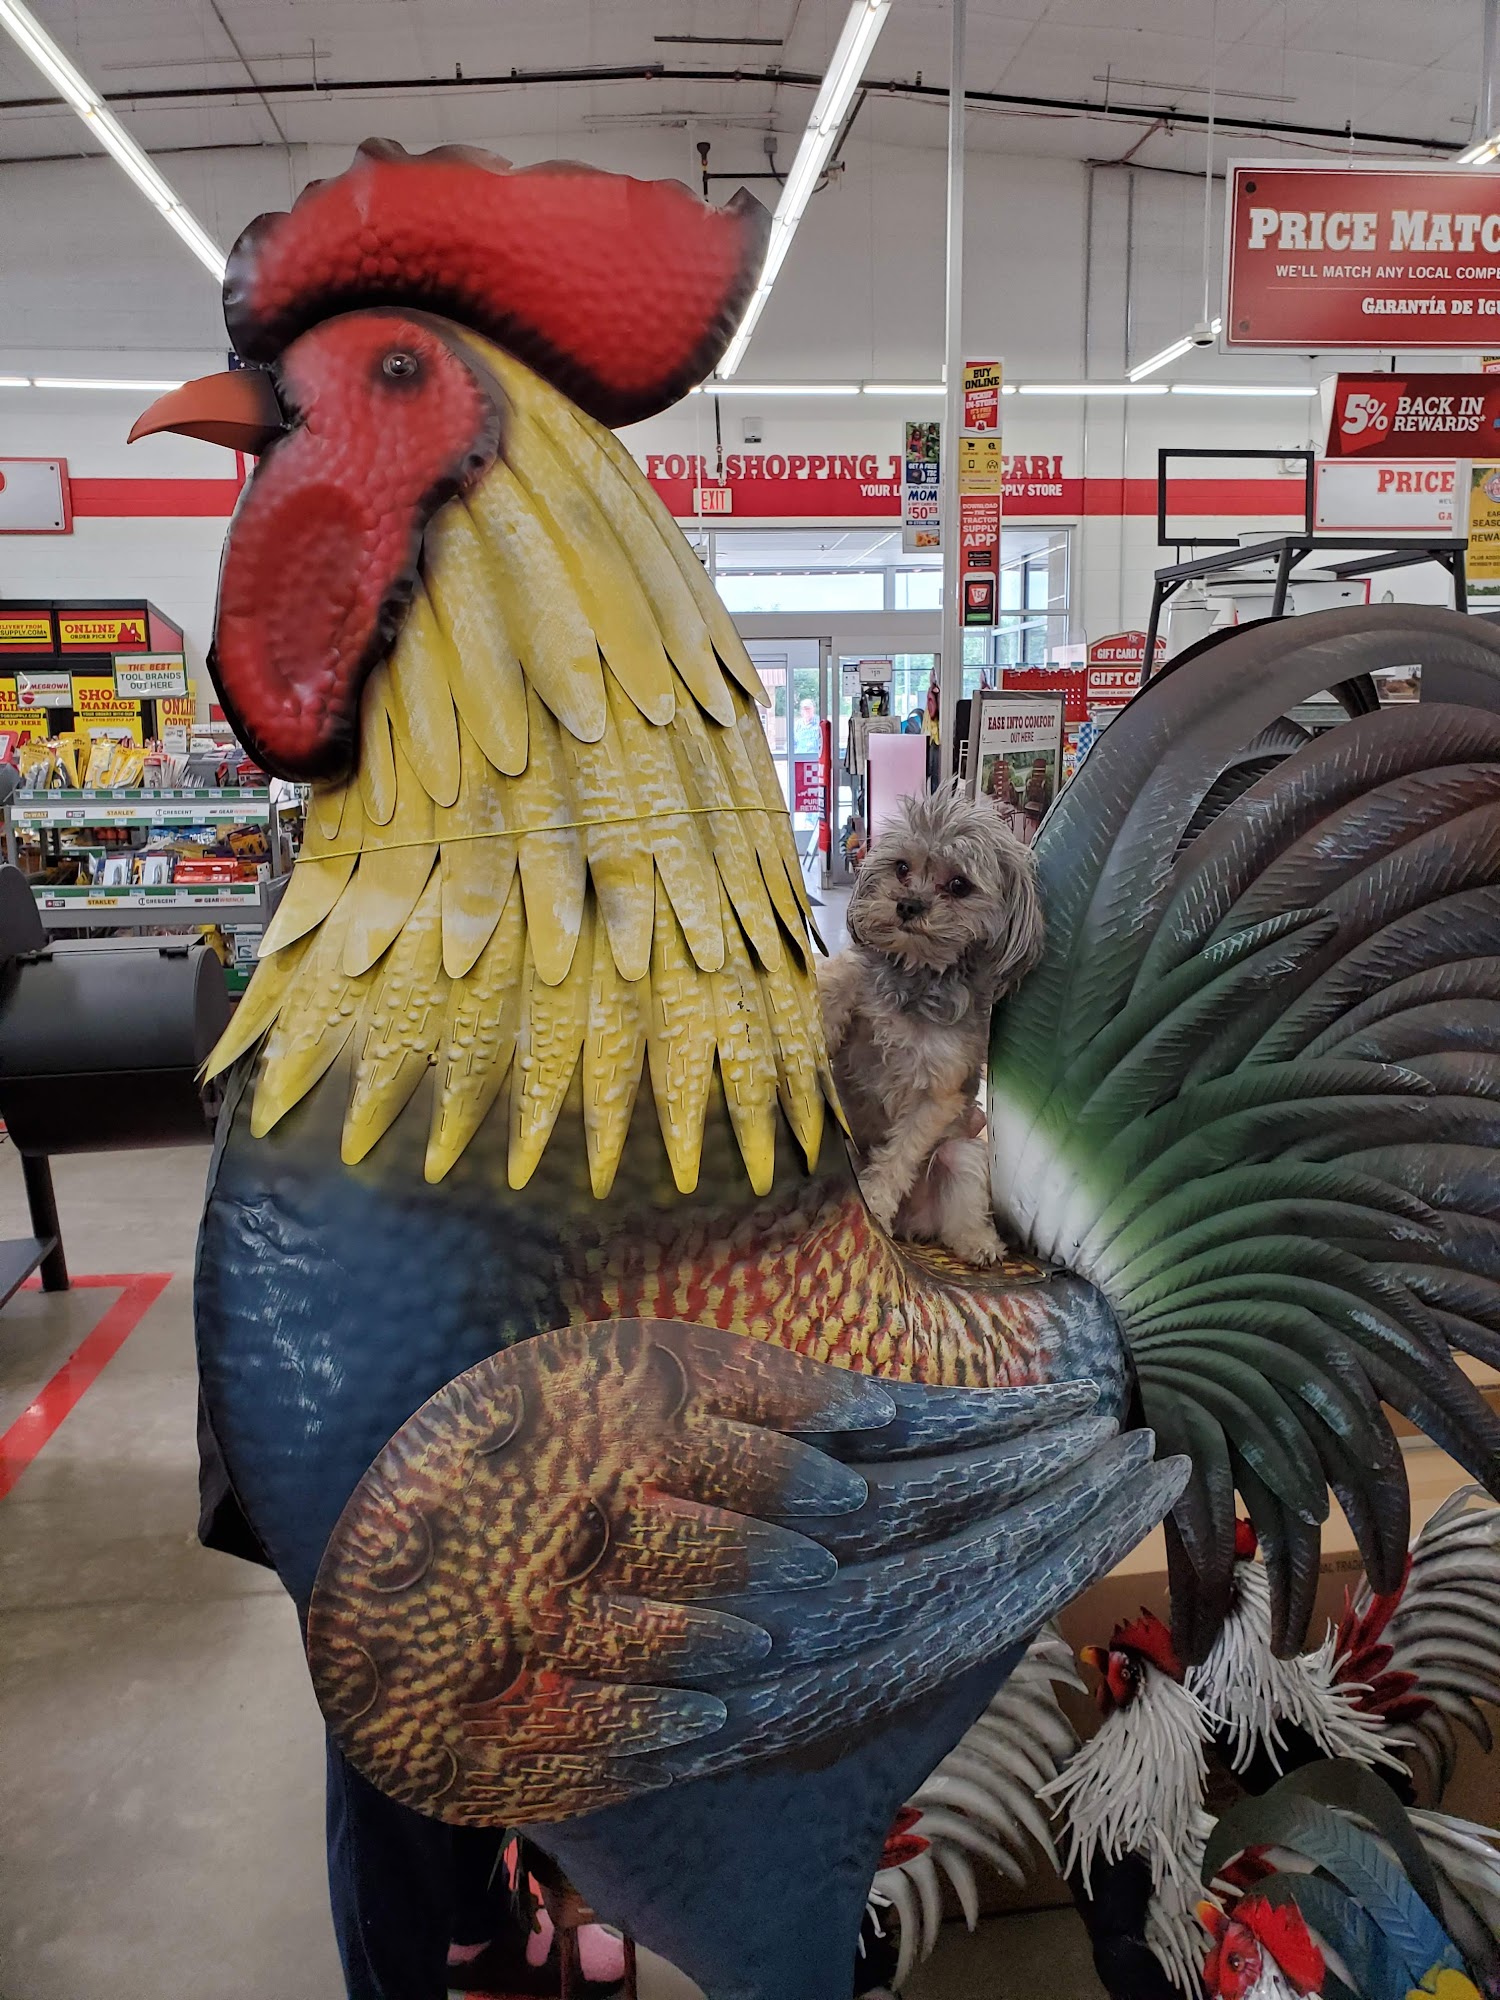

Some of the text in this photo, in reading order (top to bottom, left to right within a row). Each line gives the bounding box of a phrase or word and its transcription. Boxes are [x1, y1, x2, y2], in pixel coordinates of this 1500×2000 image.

[1248, 208, 1378, 251] PRICE
[1276, 265, 1318, 278] WE'LL
[1323, 266, 1372, 279] MATCH
[1376, 266, 1404, 279] ANY
[1408, 267, 1452, 280] LOCAL
[1362, 296, 1447, 315] GARANTÍA
[1451, 299, 1473, 315] DE
[973, 368, 991, 378] BUY
[965, 376, 999, 390] ONLINE
[1341, 394, 1485, 434] 5% BACK IN
[645, 454, 707, 480] FOR
[725, 454, 879, 480] SHOPPING
[1377, 469, 1455, 494] PRICE
[860, 484, 890, 497] YOUR
[1027, 484, 1063, 497] STORE
[908, 490, 937, 501] MOM
[701, 490, 726, 510] EXIT
[963, 524, 998, 533] SUPPLY
[963, 533, 998, 547] APP
[64, 624, 116, 634] ONLINE
[1097, 648, 1115, 660] GIFT
[1116, 648, 1137, 659] CARD
[149, 663, 171, 671] BEST
[120, 672, 181, 681] TOOL BRANDS
[1090, 672, 1123, 686] GIFT
[130, 681, 173, 690] OUT HERE
[79, 689, 115, 700] SHO
[81, 702, 135, 710] MANAGE
[988, 715, 1055, 730] EASE INTO COMFORT
[1010, 732, 1034, 743] OUT HERE
